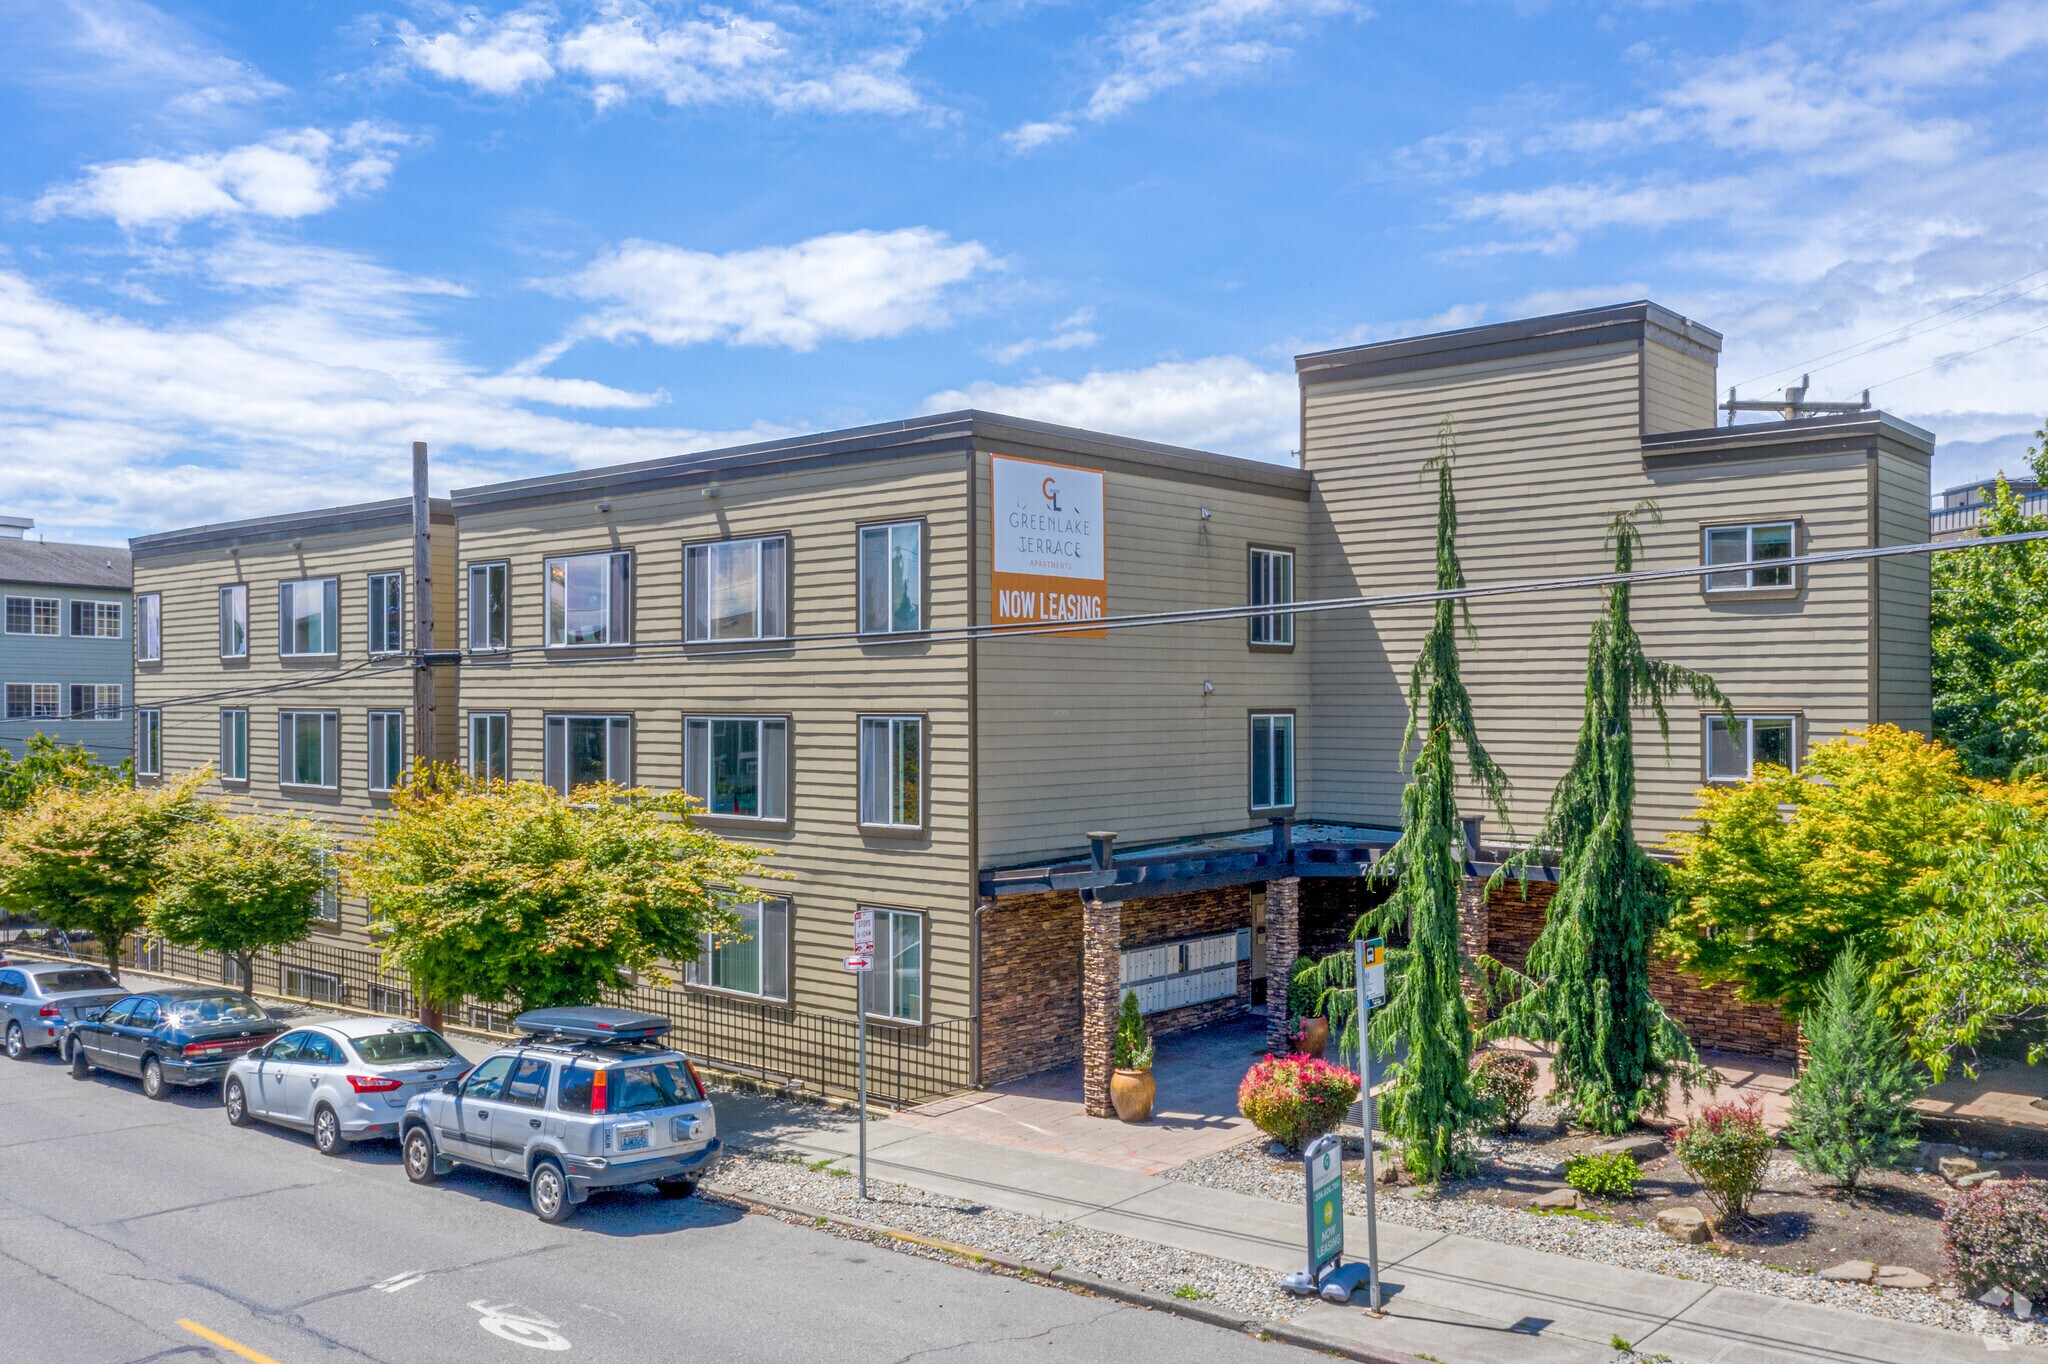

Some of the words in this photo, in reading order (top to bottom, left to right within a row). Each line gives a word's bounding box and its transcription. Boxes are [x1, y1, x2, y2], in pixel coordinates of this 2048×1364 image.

[1009, 512, 1090, 536] GREENLAKE
[1018, 536, 1083, 558] TERRACE
[1029, 559, 1072, 570] APARTMENTS
[999, 589, 1036, 619] NOW
[1040, 592, 1101, 621] LEASING
[1321, 1223, 1337, 1241] NOW
[1317, 1234, 1341, 1258] LEASING
